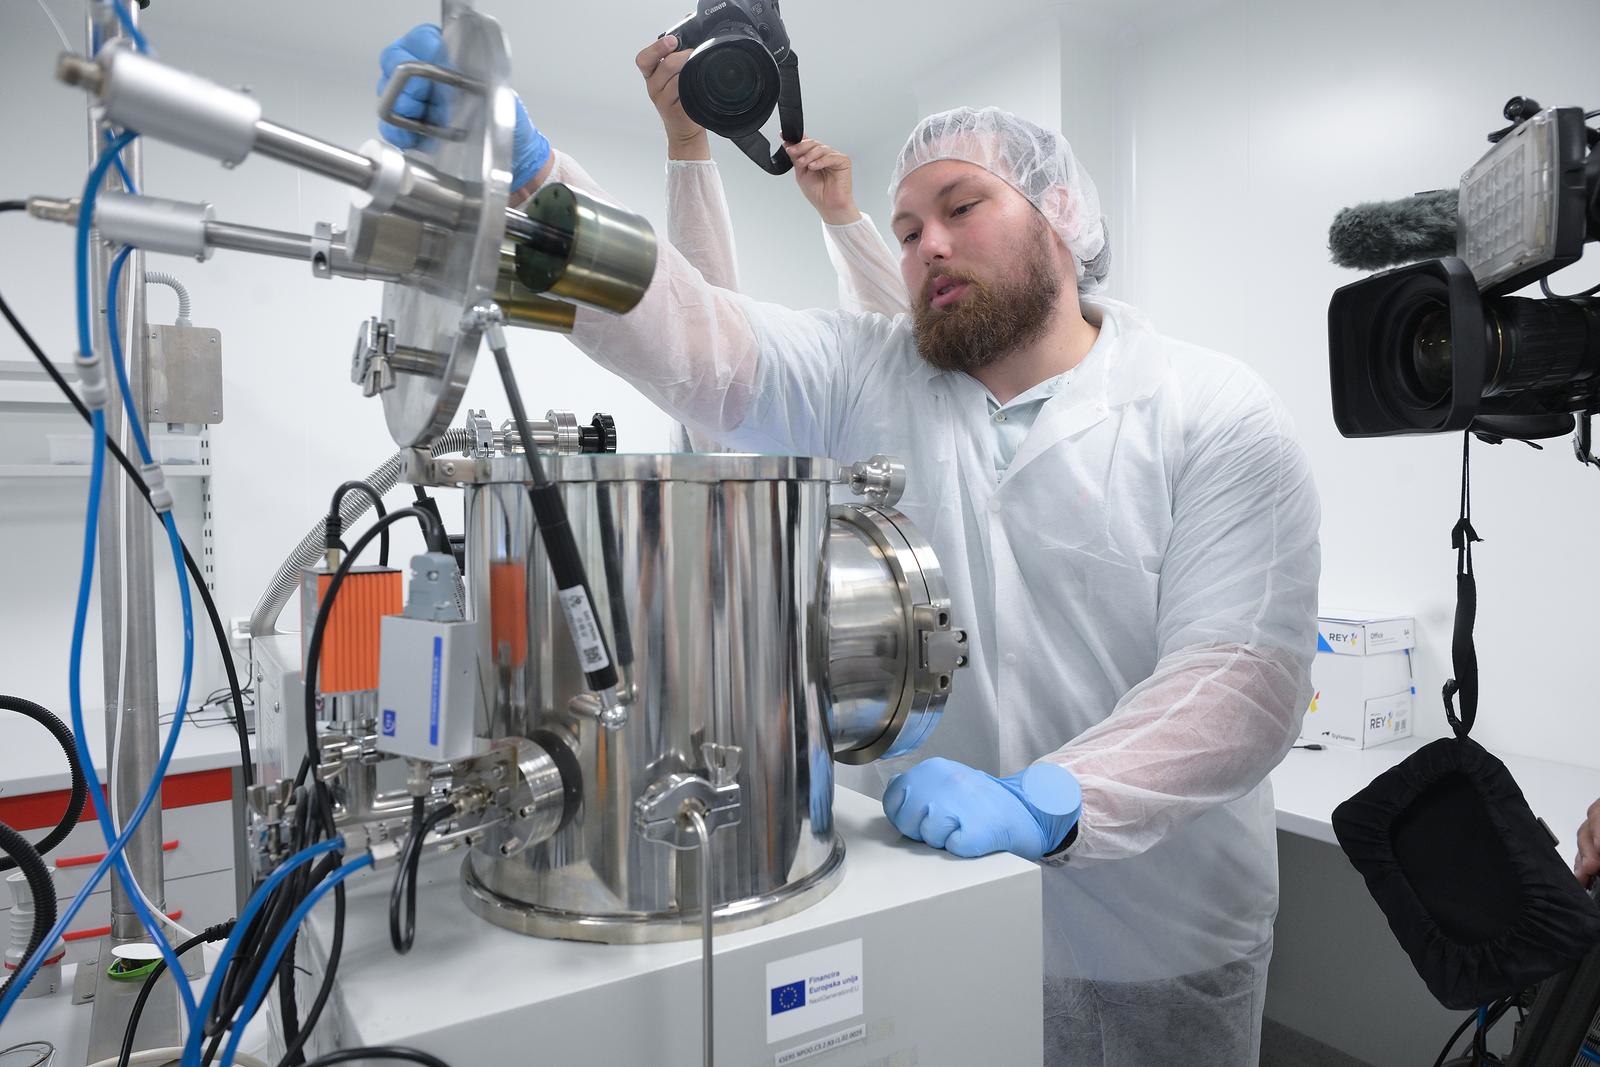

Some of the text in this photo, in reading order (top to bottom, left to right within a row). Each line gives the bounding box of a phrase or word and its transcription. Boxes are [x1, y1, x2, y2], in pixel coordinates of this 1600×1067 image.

[704, 1, 727, 16] Canon
[1329, 632, 1348, 642] REY
[1370, 716, 1387, 730] REY
[809, 971, 840, 985] Financira
[809, 975, 858, 995] Europska unija
